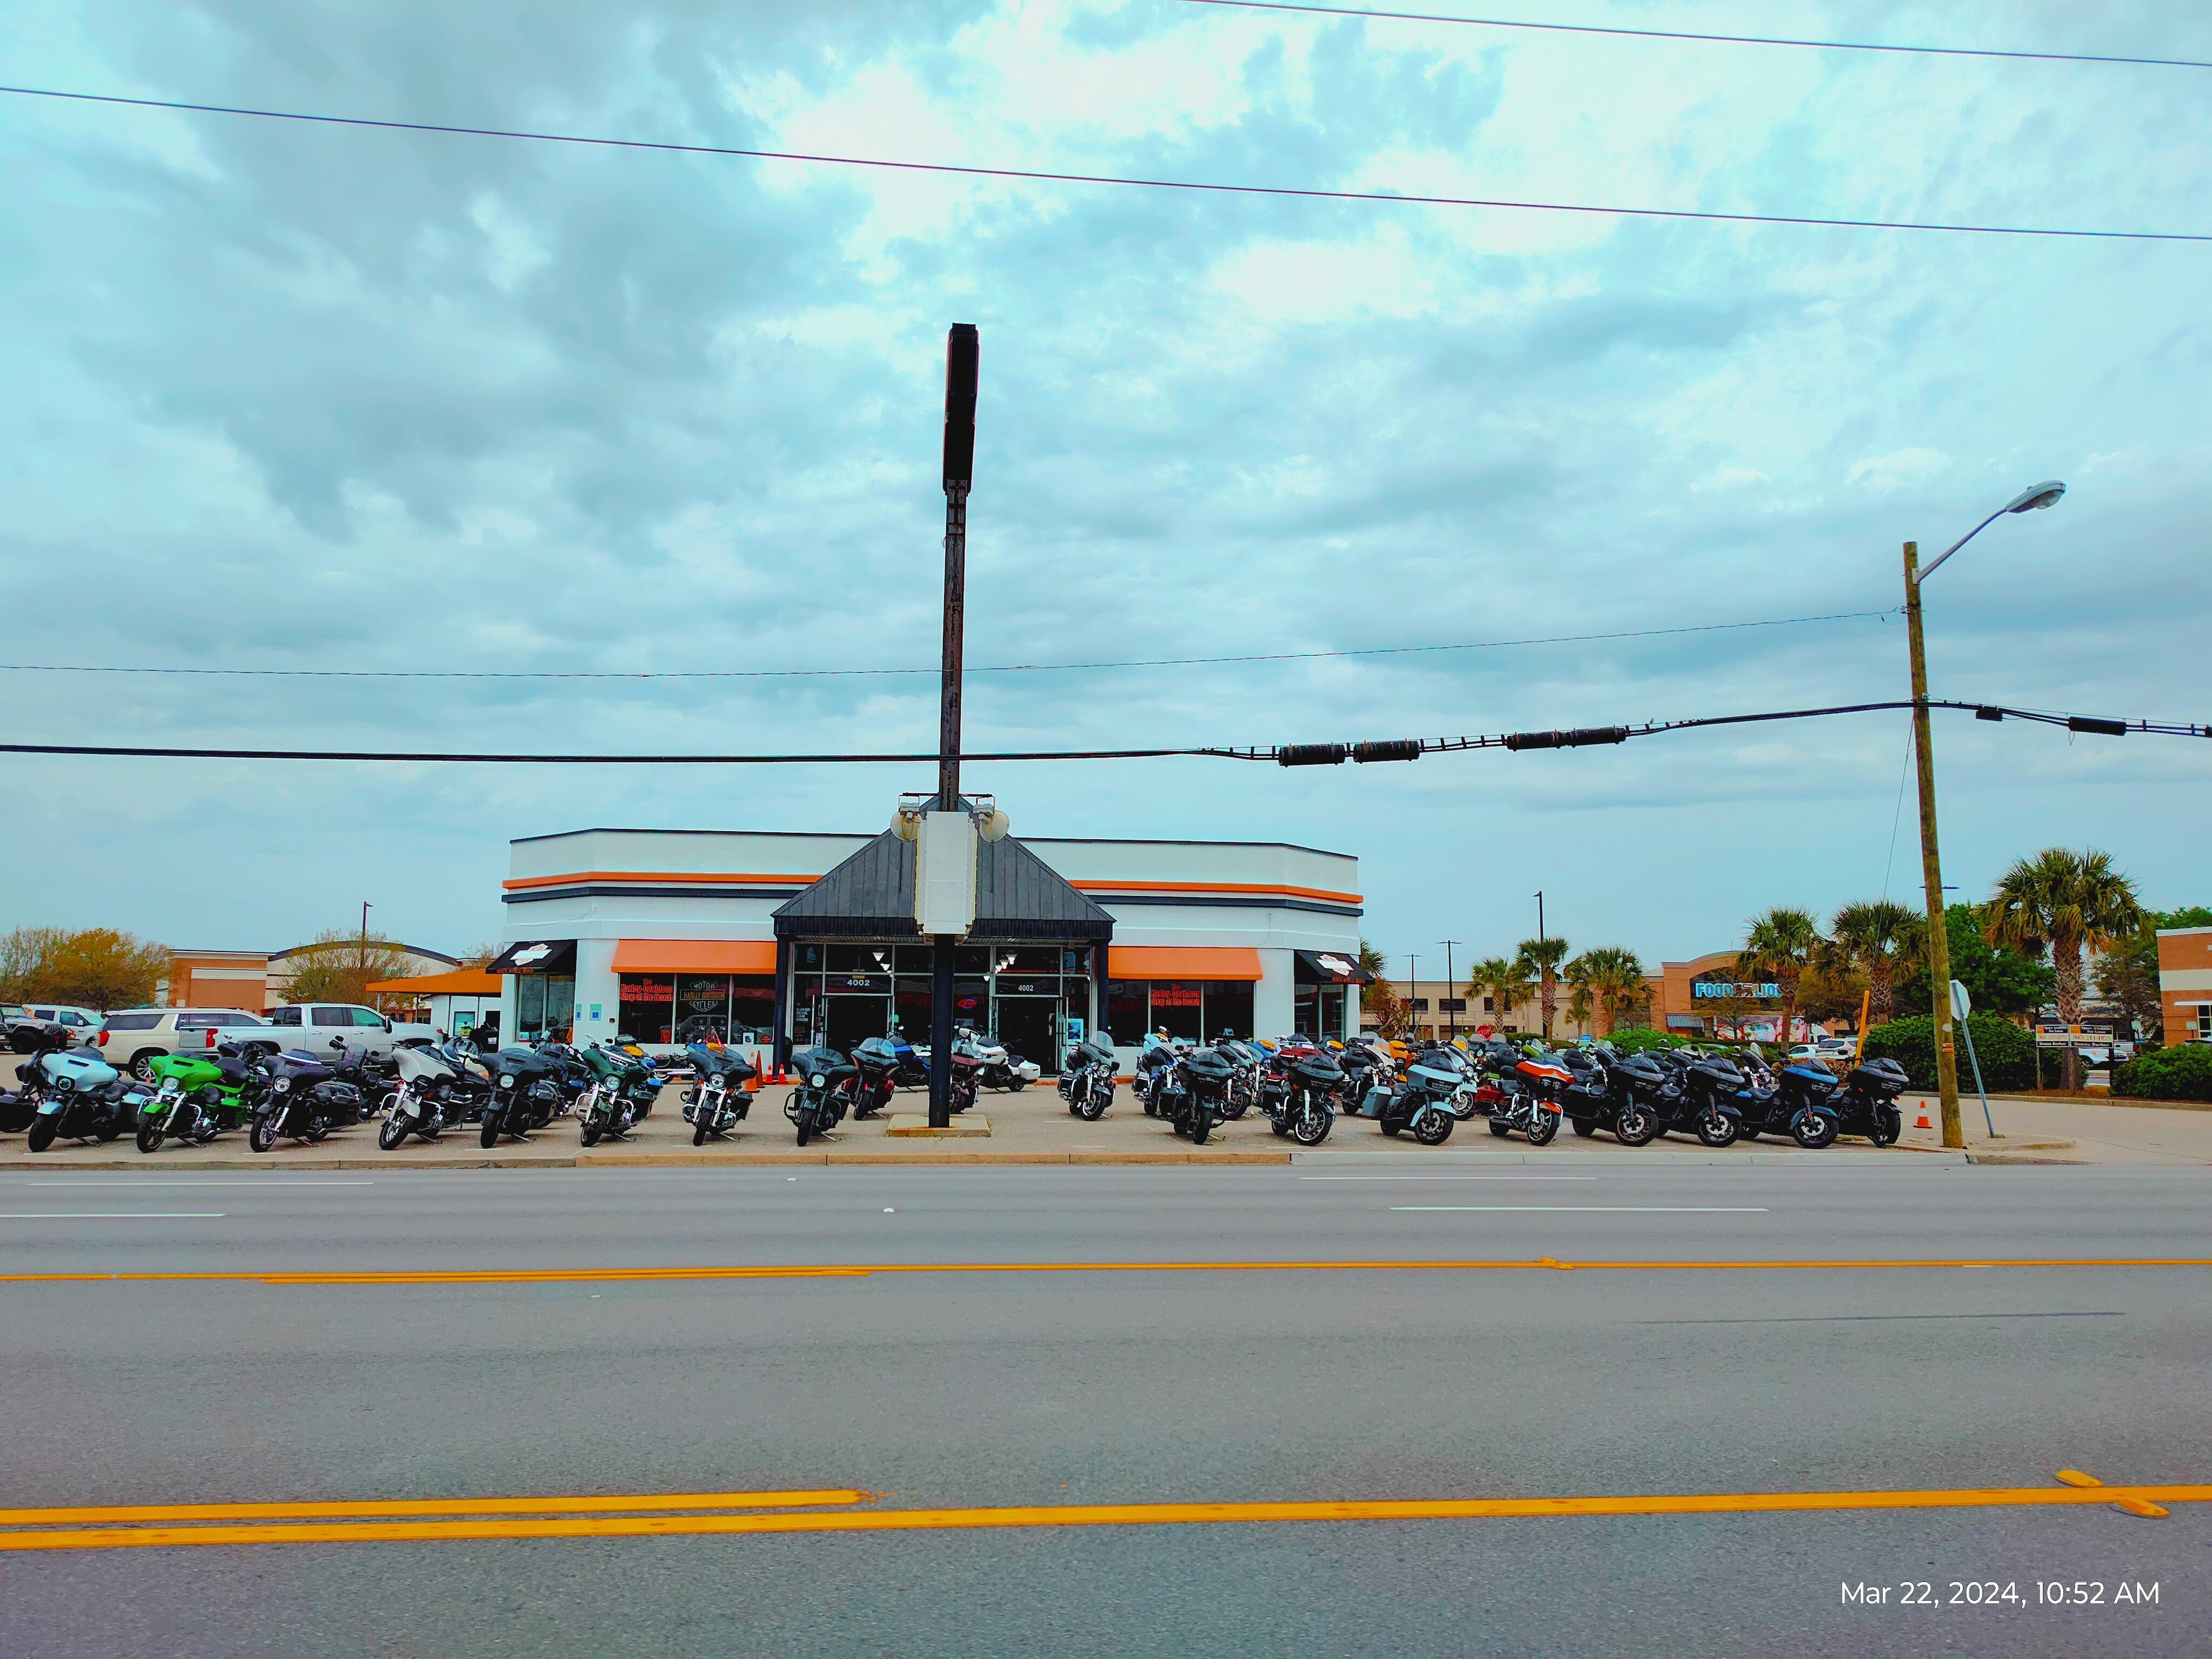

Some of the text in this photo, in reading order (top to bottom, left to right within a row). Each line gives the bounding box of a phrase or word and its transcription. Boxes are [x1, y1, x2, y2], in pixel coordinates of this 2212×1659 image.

[694, 981, 715, 989] MOTOR
[1695, 983, 1733, 997] FOOD
[620, 993, 635, 1002] Shop
[636, 993, 643, 1001] at
[654, 993, 673, 1002] Beach
[693, 1001, 715, 1010] CYCLES
[1478, 1028, 1490, 1036] STOP
